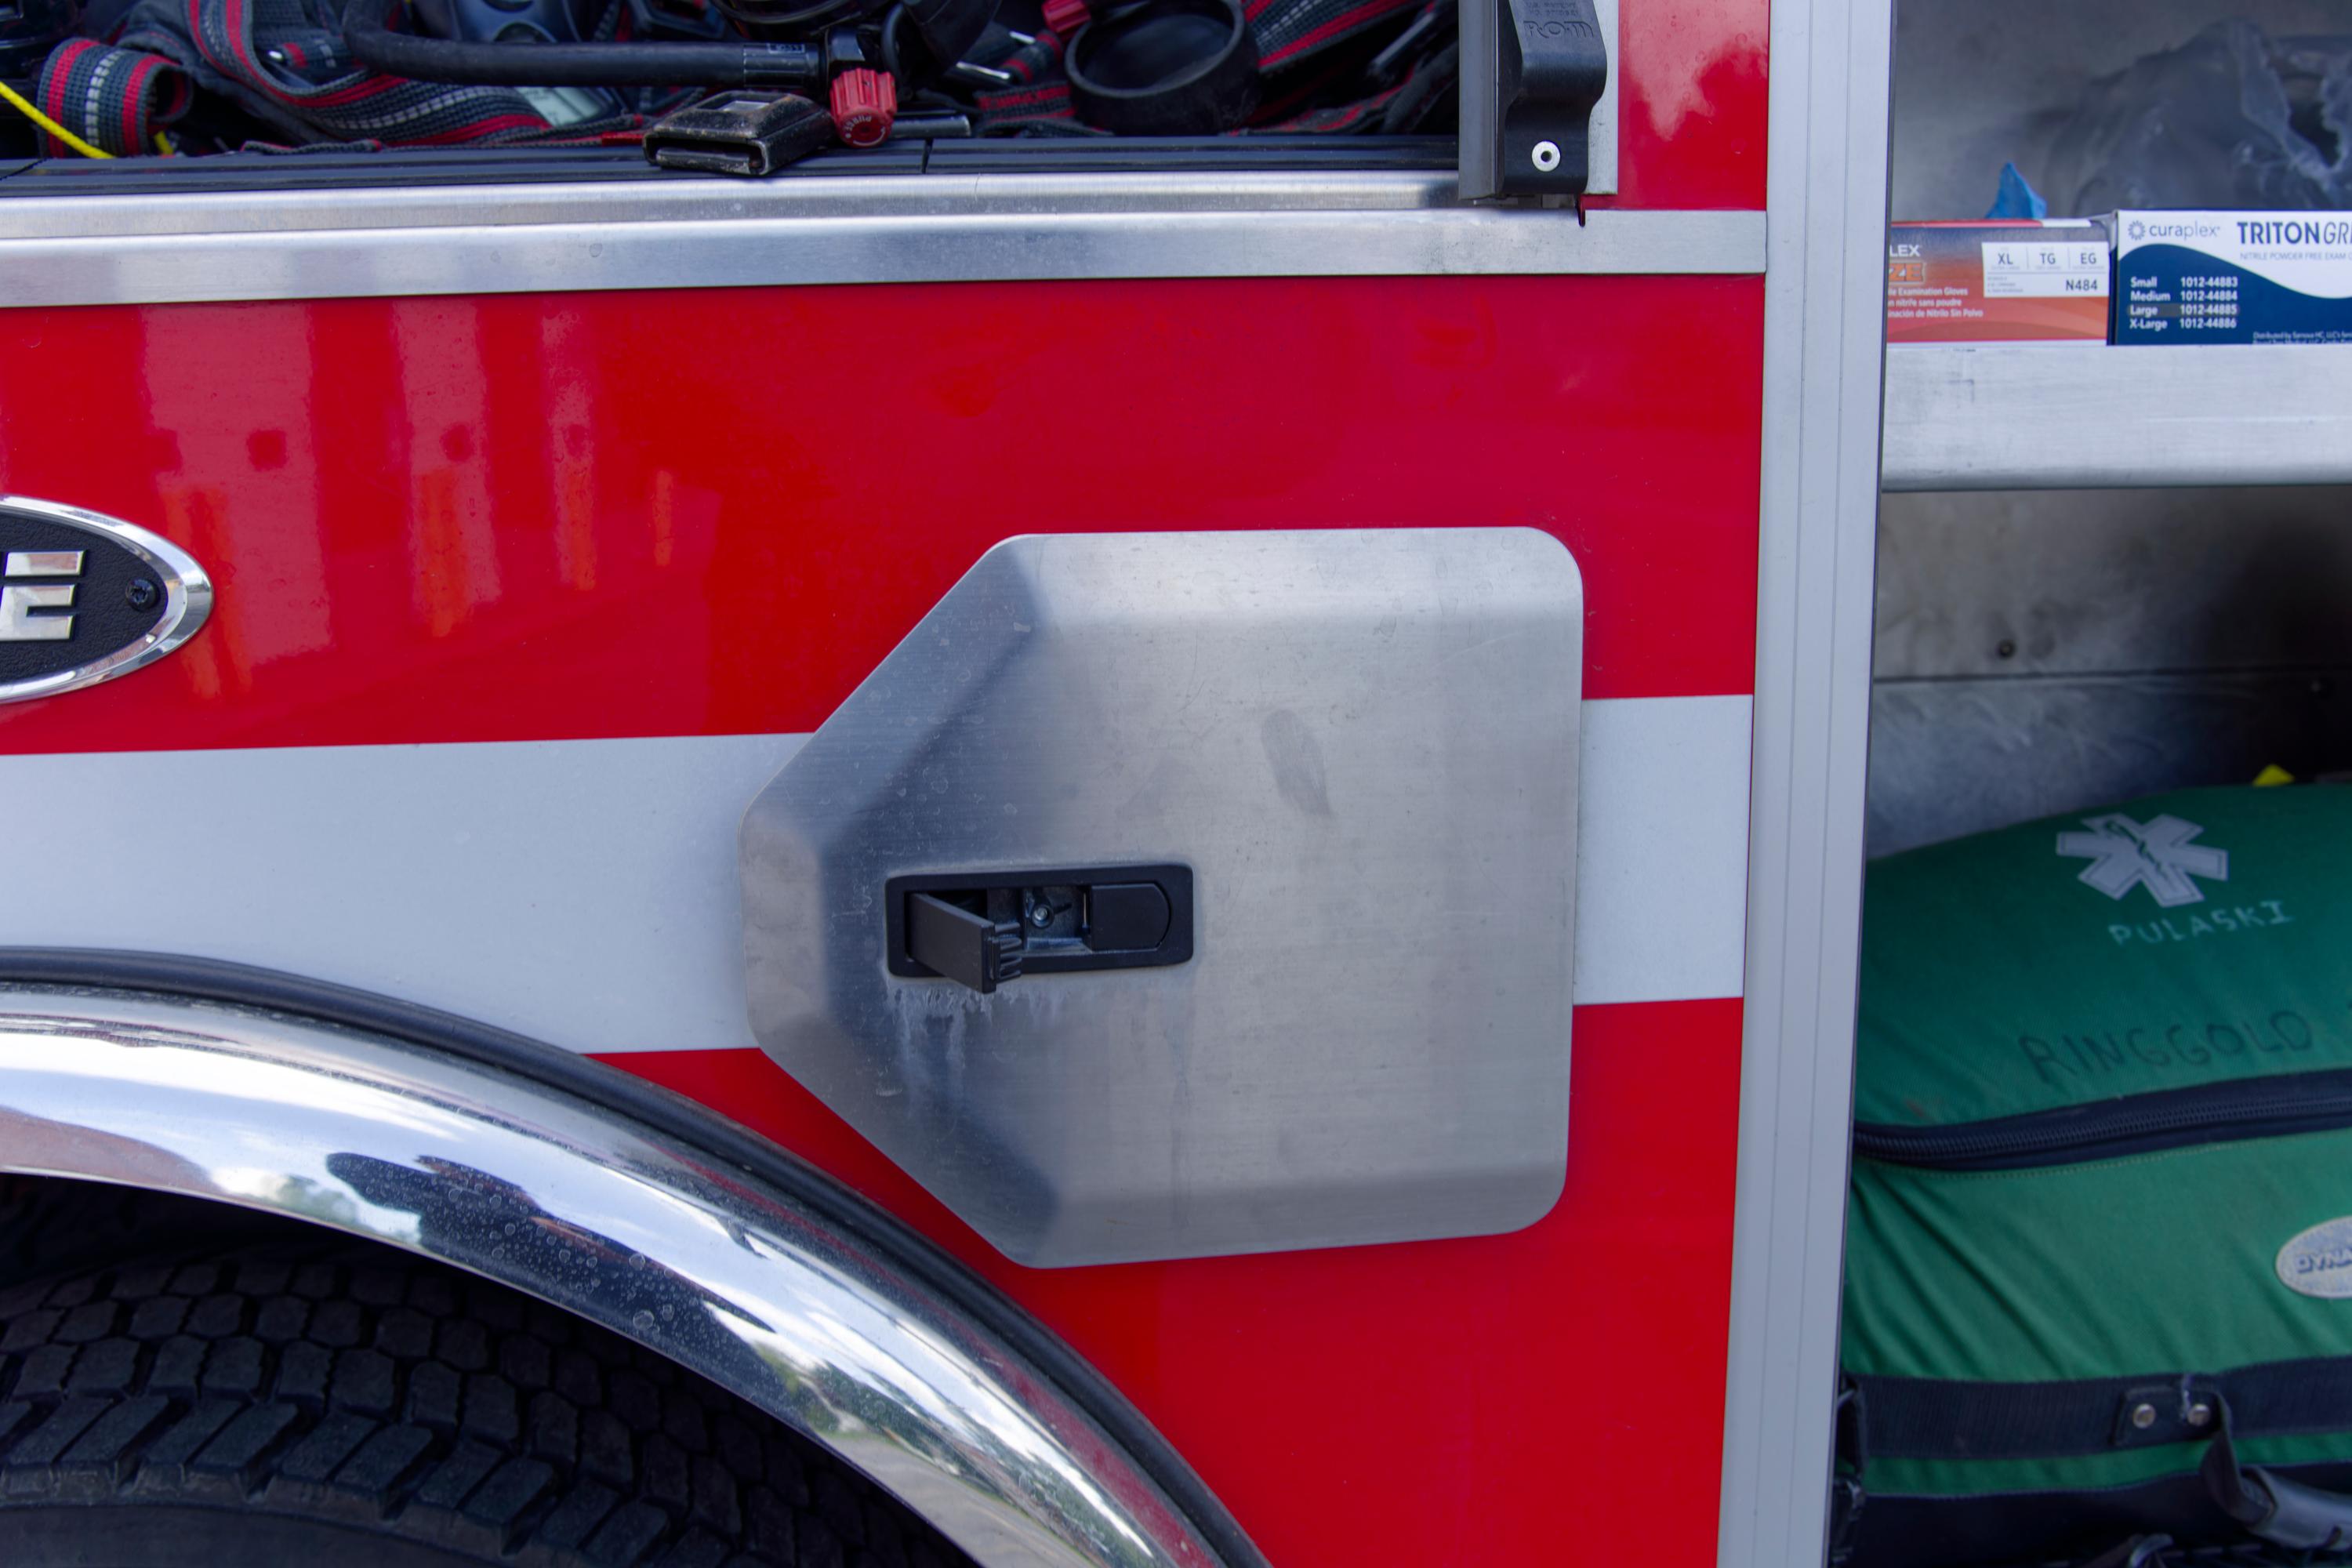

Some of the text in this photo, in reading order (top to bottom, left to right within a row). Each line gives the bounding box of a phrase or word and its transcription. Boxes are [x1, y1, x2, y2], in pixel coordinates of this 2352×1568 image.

[2149, 220, 2218, 240] curaplex
[1998, 253, 2097, 264] XL TG EG
[2305, 252, 2322, 260] FREE
[2066, 279, 2098, 291] N484
[2130, 276, 2238, 288] Small 1012-44883
[1898, 288, 1943, 296] Examination
[1944, 287, 1969, 296] Gloves
[2130, 290, 2238, 302] Medium 1012-44884
[1915, 309, 1926, 318] de
[1951, 309, 1962, 318] Sin
[1963, 309, 1984, 318] Polvo
[2130, 303, 2238, 318] Large 1012-44885
[2129, 318, 2237, 332] X-Large 1012-44886
[2108, 900, 2294, 946] PULASKI
